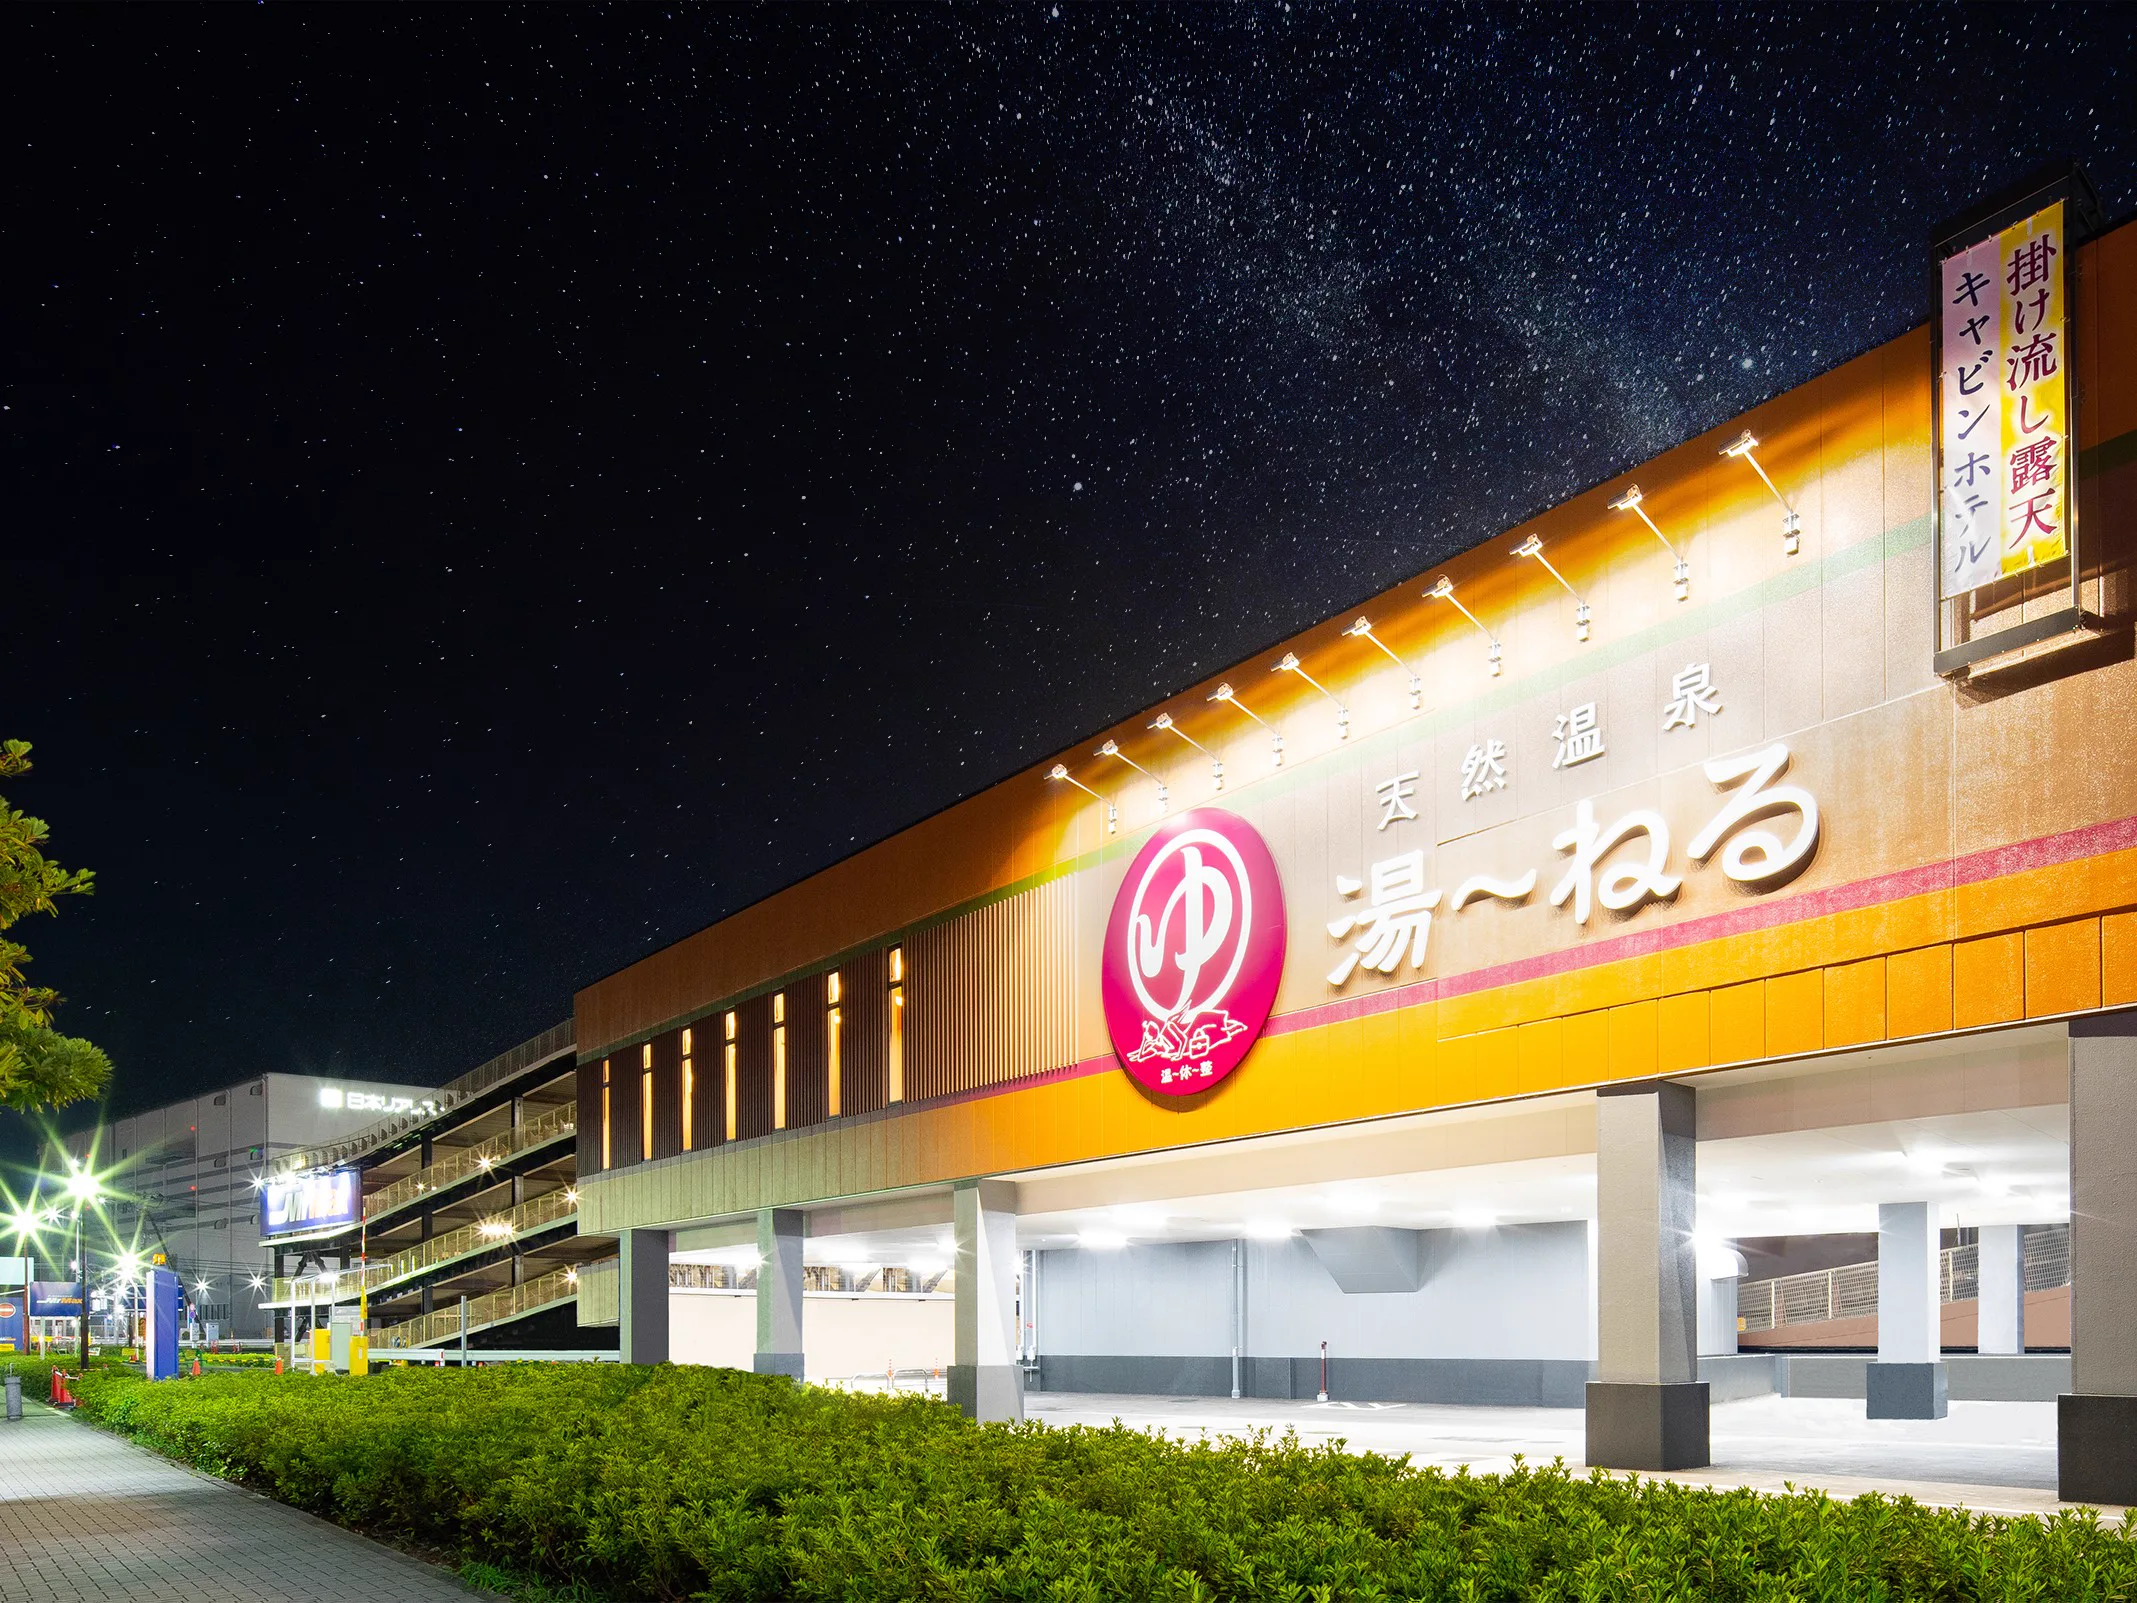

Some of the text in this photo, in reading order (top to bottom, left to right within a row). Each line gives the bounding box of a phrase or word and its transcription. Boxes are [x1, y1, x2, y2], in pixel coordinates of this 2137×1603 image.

[1952, 271, 1993, 574] キャビンホテル
[2006, 234, 2057, 549] 掛け流し露天
[1375, 662, 1723, 831] 天然温泉
[1136, 846, 1233, 1010] ゆ
